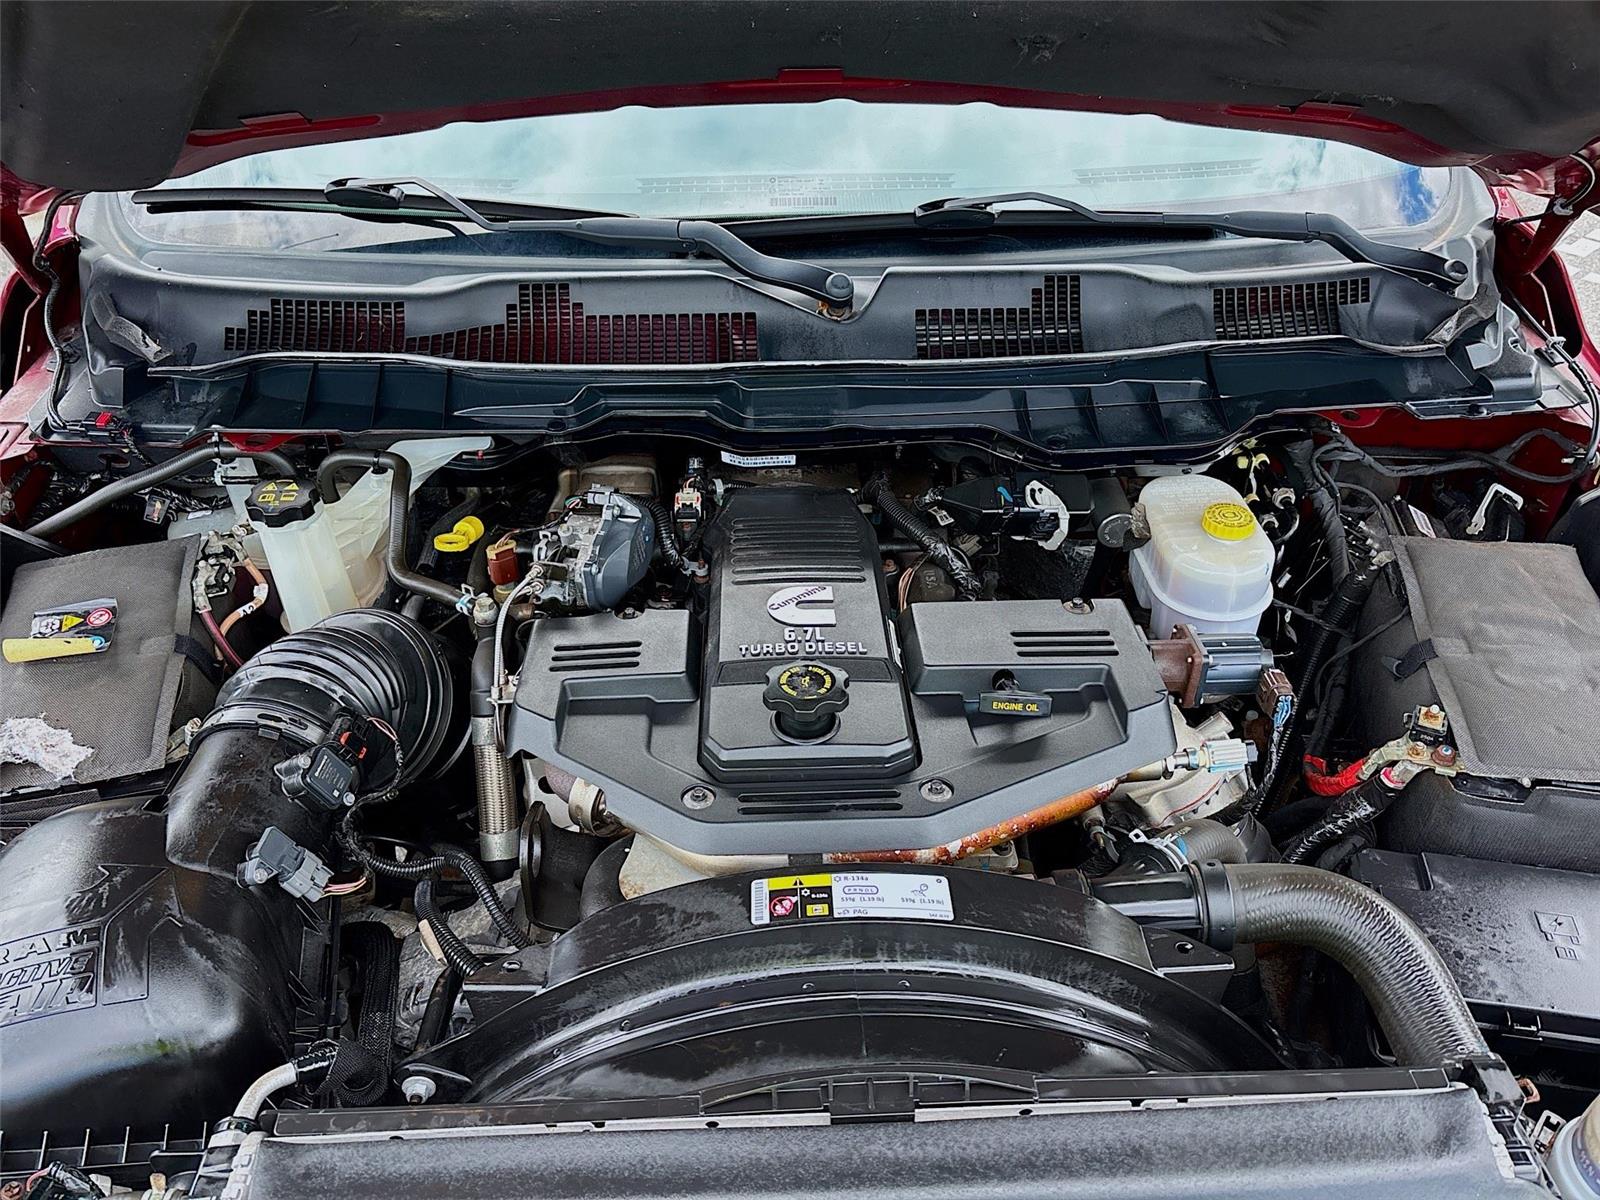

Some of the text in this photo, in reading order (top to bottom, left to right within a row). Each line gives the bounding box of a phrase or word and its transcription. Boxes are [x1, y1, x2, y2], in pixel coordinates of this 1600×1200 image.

[769, 585, 827, 610] Cummins
[783, 627, 825, 643] 6.7L
[739, 641, 867, 657] TURBO DIESEL
[992, 701, 1039, 712] ENGINE OIL
[0, 952, 93, 990] CTIVE
